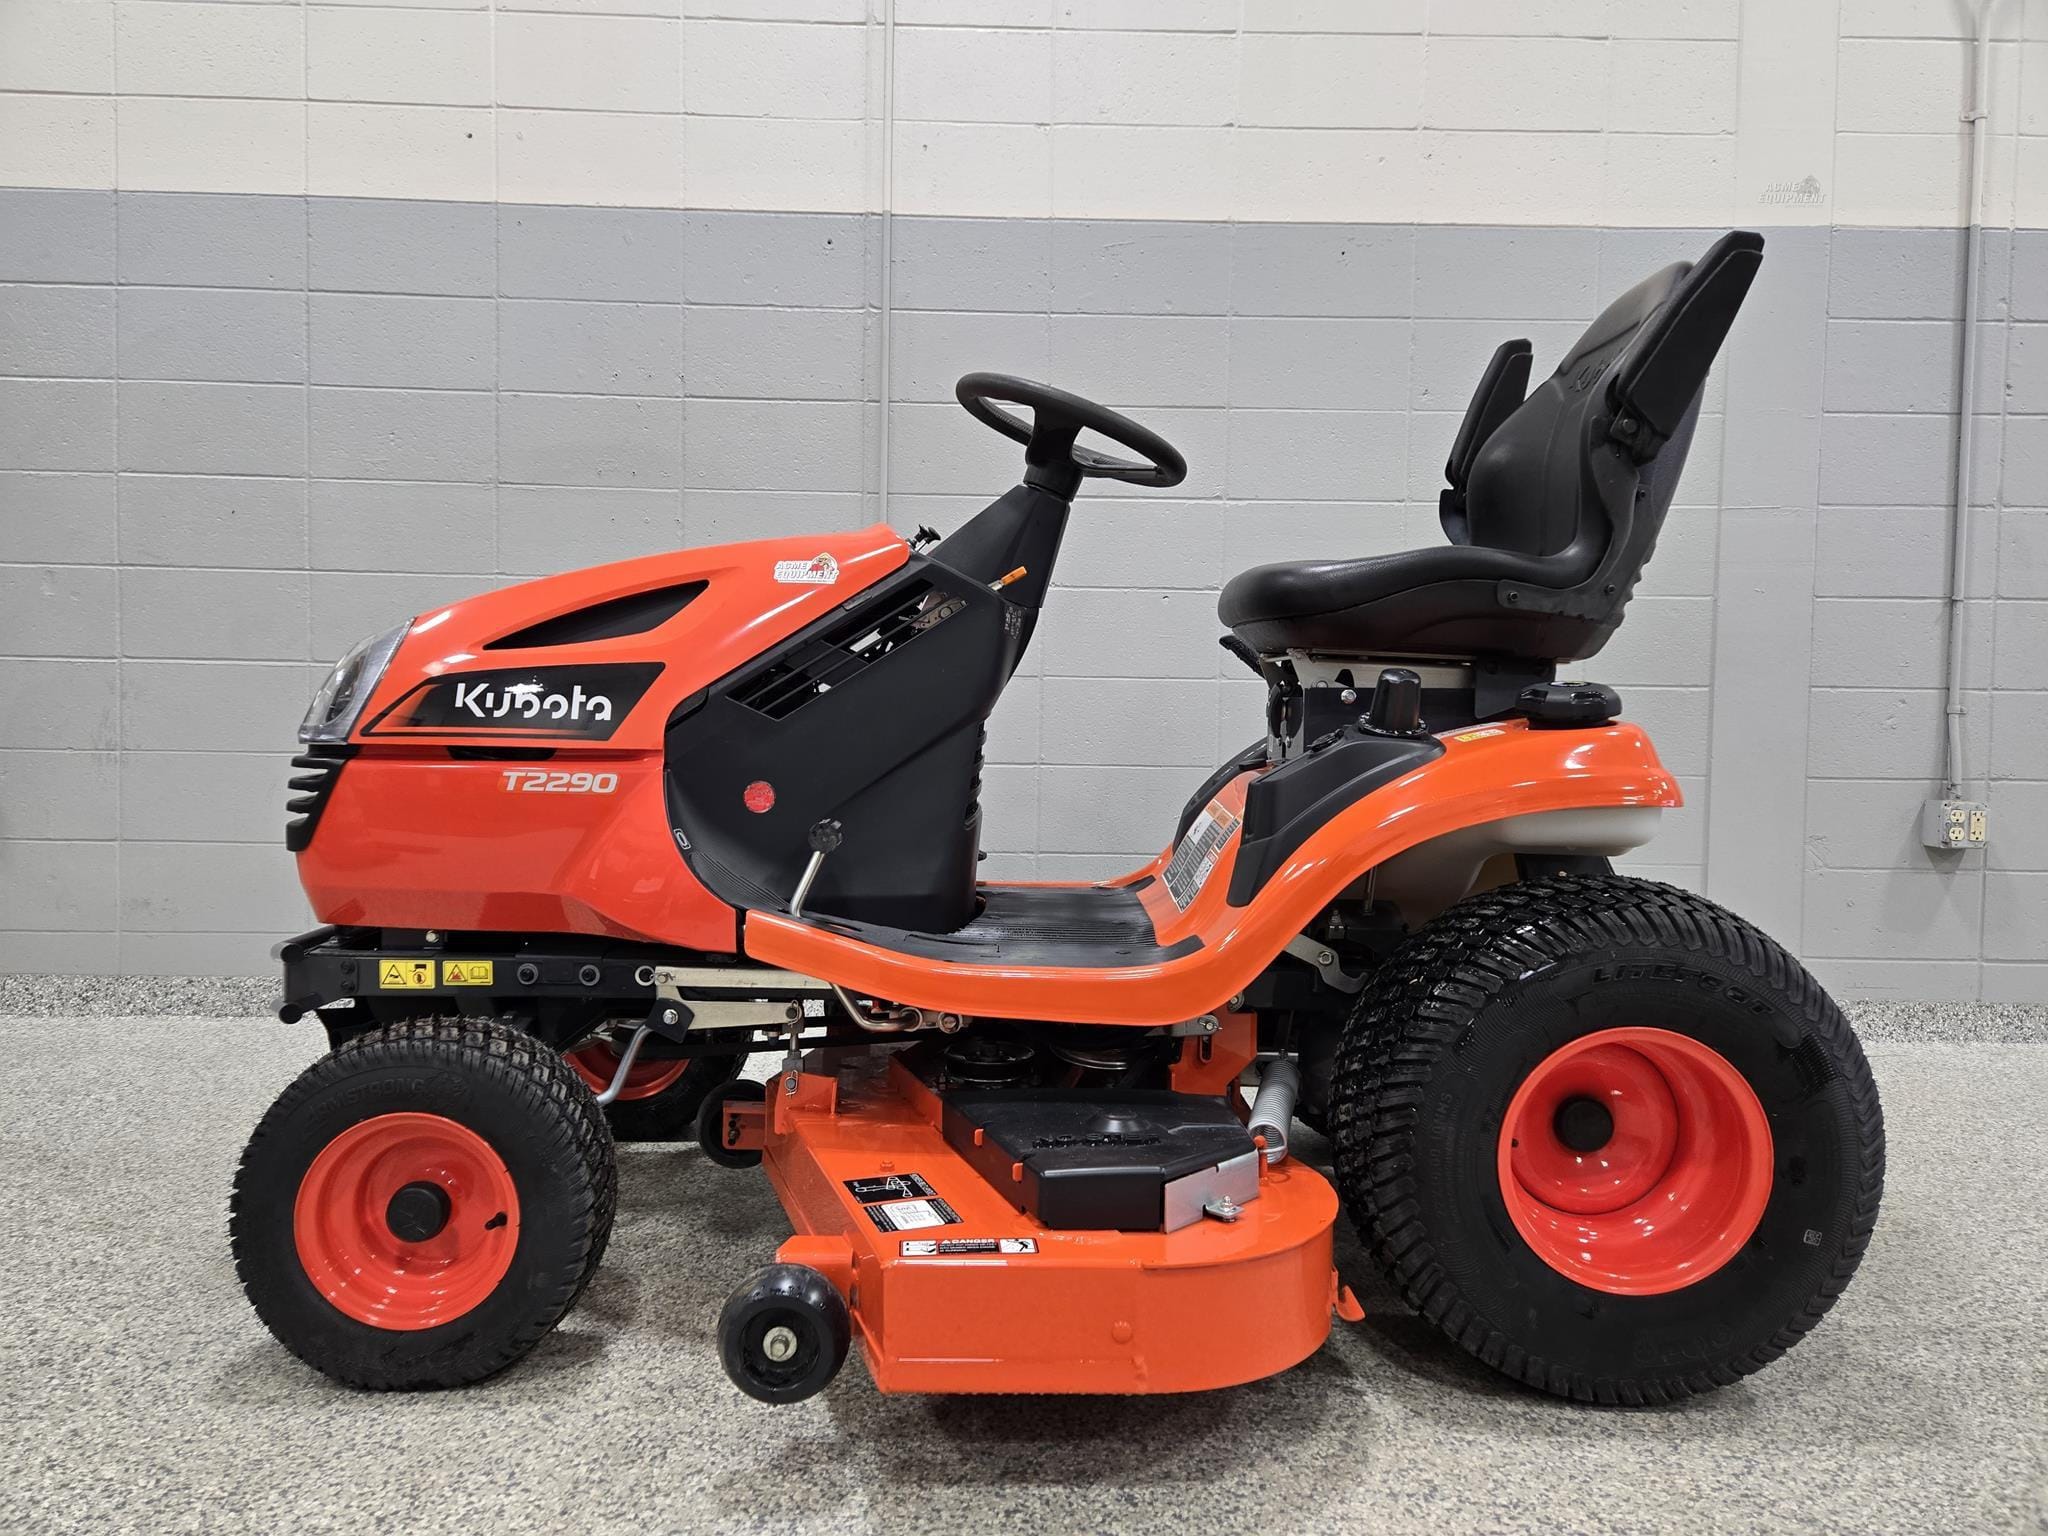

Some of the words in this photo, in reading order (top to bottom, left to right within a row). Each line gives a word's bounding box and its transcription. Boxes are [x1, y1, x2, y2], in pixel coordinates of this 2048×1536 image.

[776, 570, 838, 580] EQUIPMENT
[454, 683, 612, 721] Kubota
[502, 771, 618, 794] T2290
